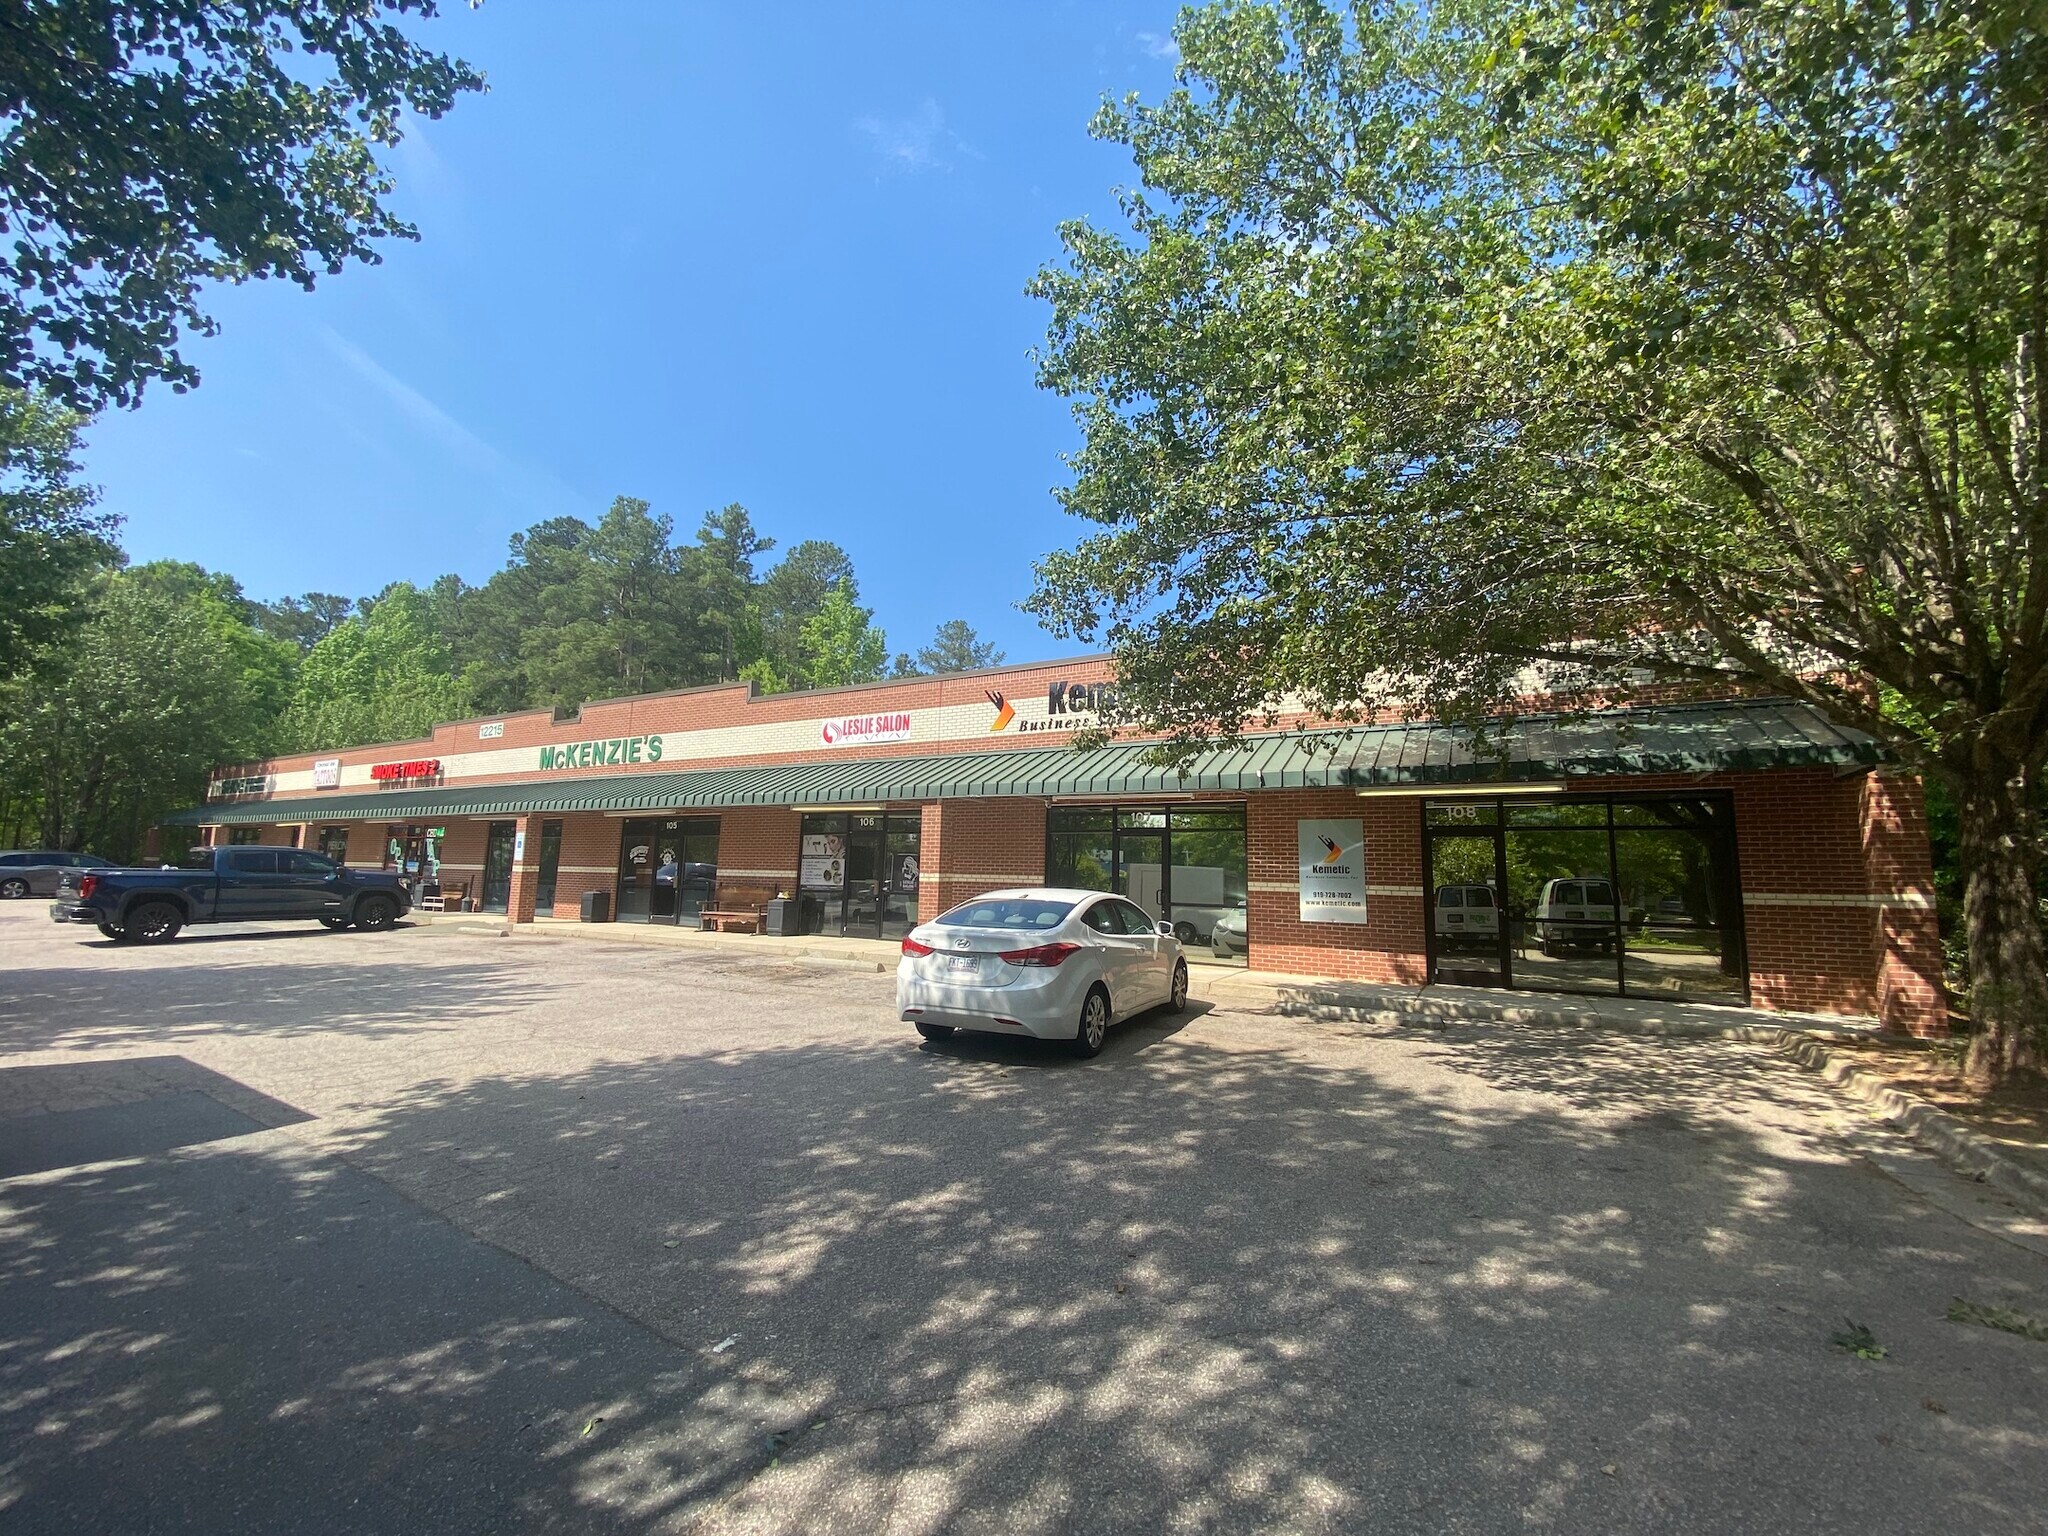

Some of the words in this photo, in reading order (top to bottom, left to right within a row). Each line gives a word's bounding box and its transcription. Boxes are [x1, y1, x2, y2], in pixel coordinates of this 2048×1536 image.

[842, 717, 874, 736] LESLIE
[875, 713, 911, 733] SALON
[1018, 716, 1090, 732] Business
[480, 724, 503, 738] 12215
[539, 735, 663, 770] McKENZIE'S
[371, 763, 400, 780] SMOKE
[400, 760, 429, 778] TIMES
[1130, 811, 1151, 822] 107
[1445, 805, 1477, 818] 108
[666, 821, 678, 830] 105
[859, 817, 875, 827] 106
[1312, 864, 1351, 875] Kemetic
